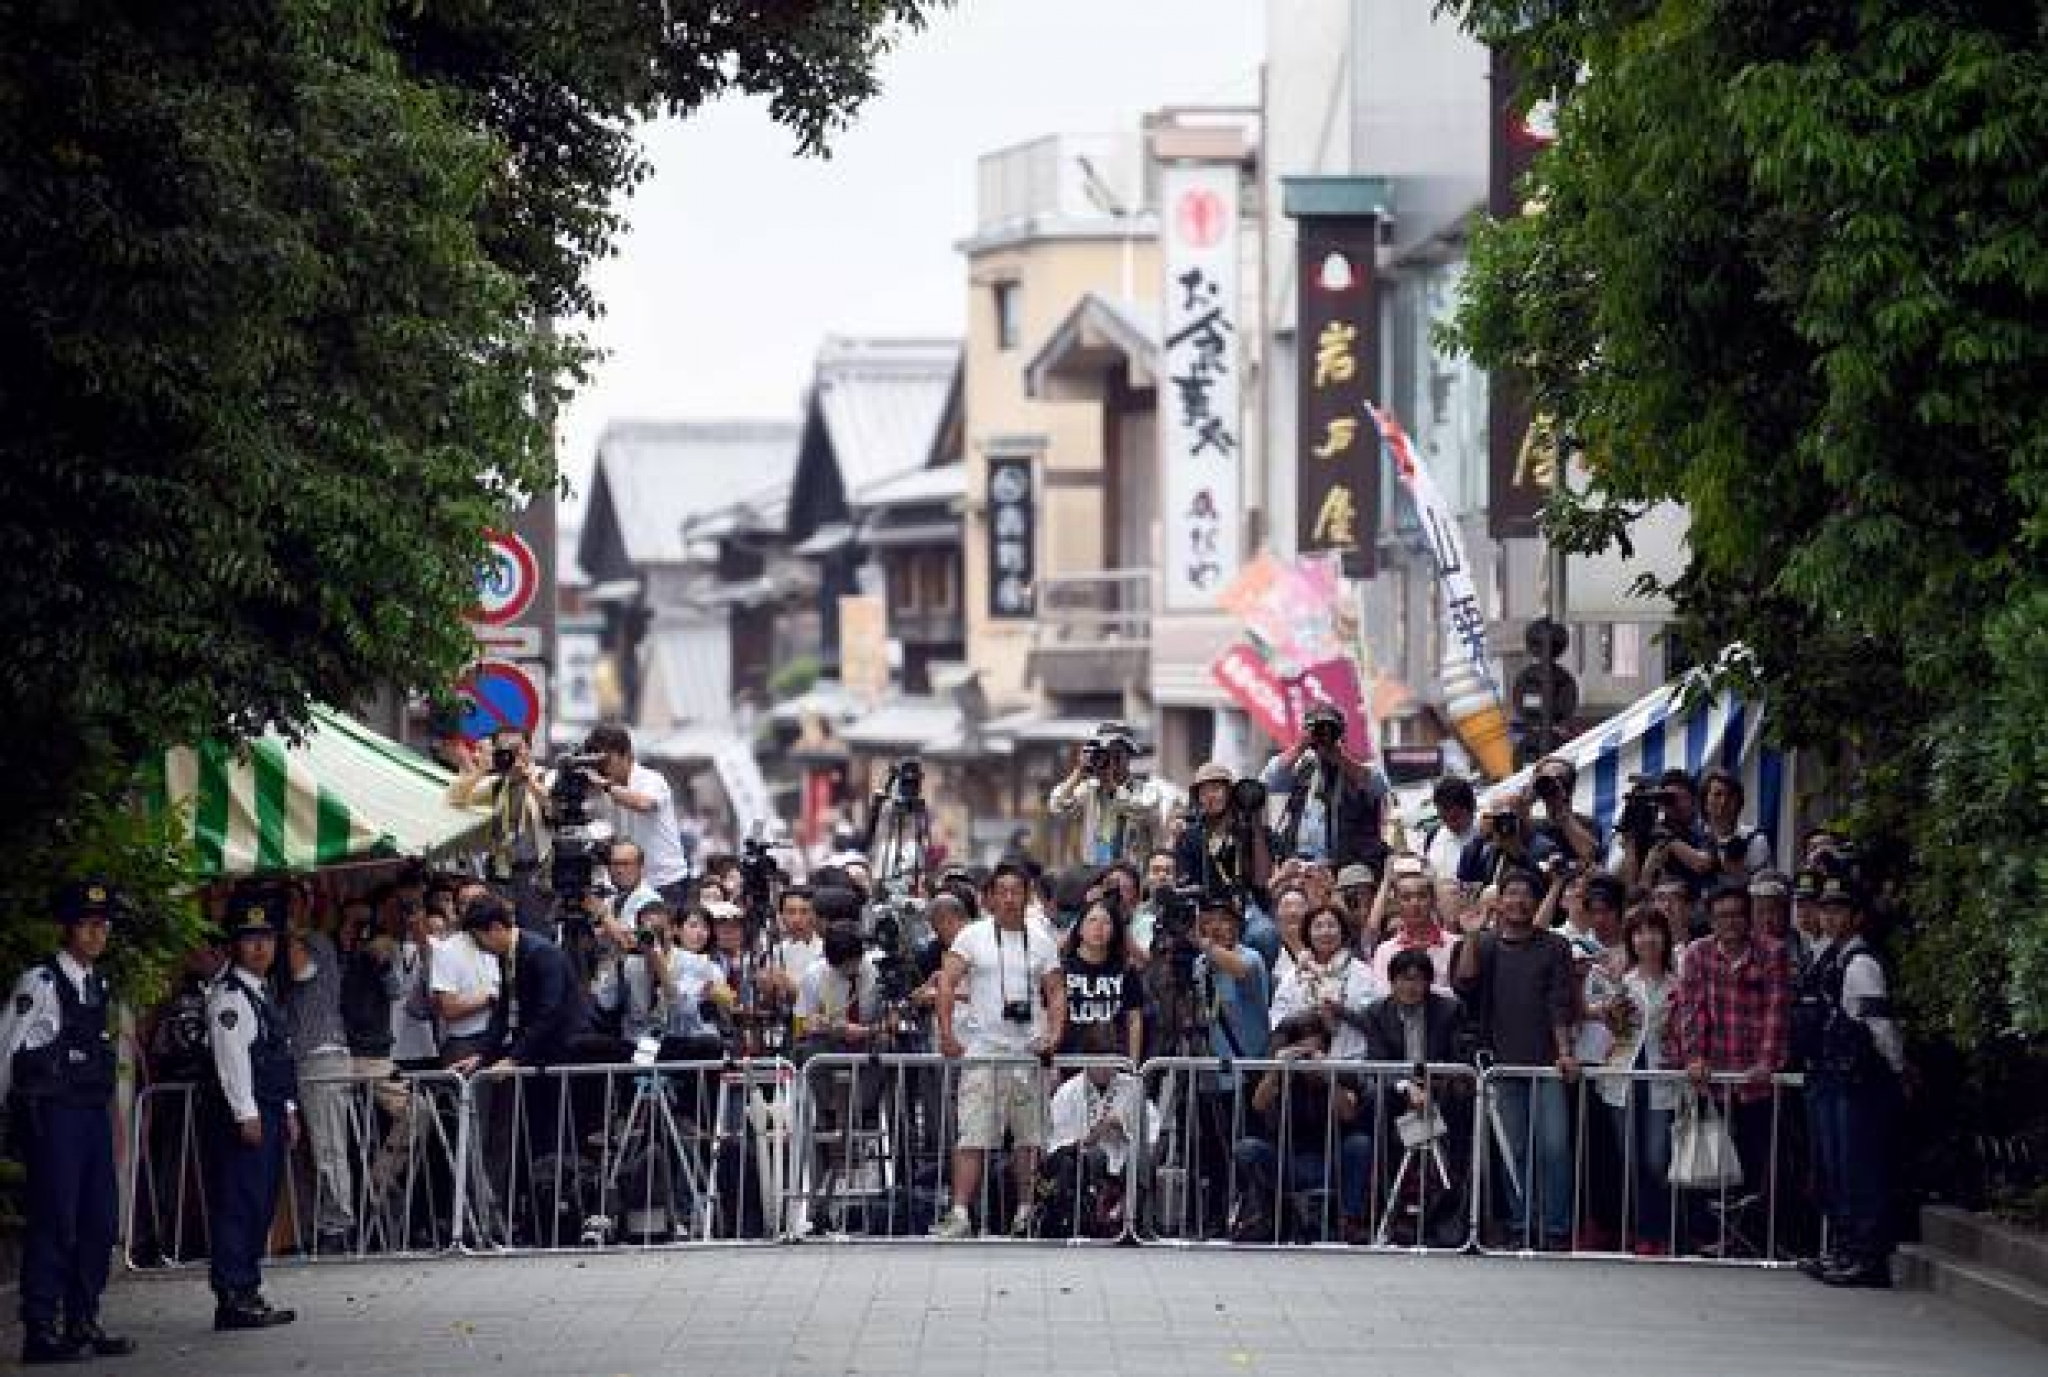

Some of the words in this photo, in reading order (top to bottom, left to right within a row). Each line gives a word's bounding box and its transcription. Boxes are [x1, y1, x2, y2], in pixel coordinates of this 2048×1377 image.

[1313, 321, 1358, 551] 岩戸屋
[1066, 973, 1123, 998] PLAY
